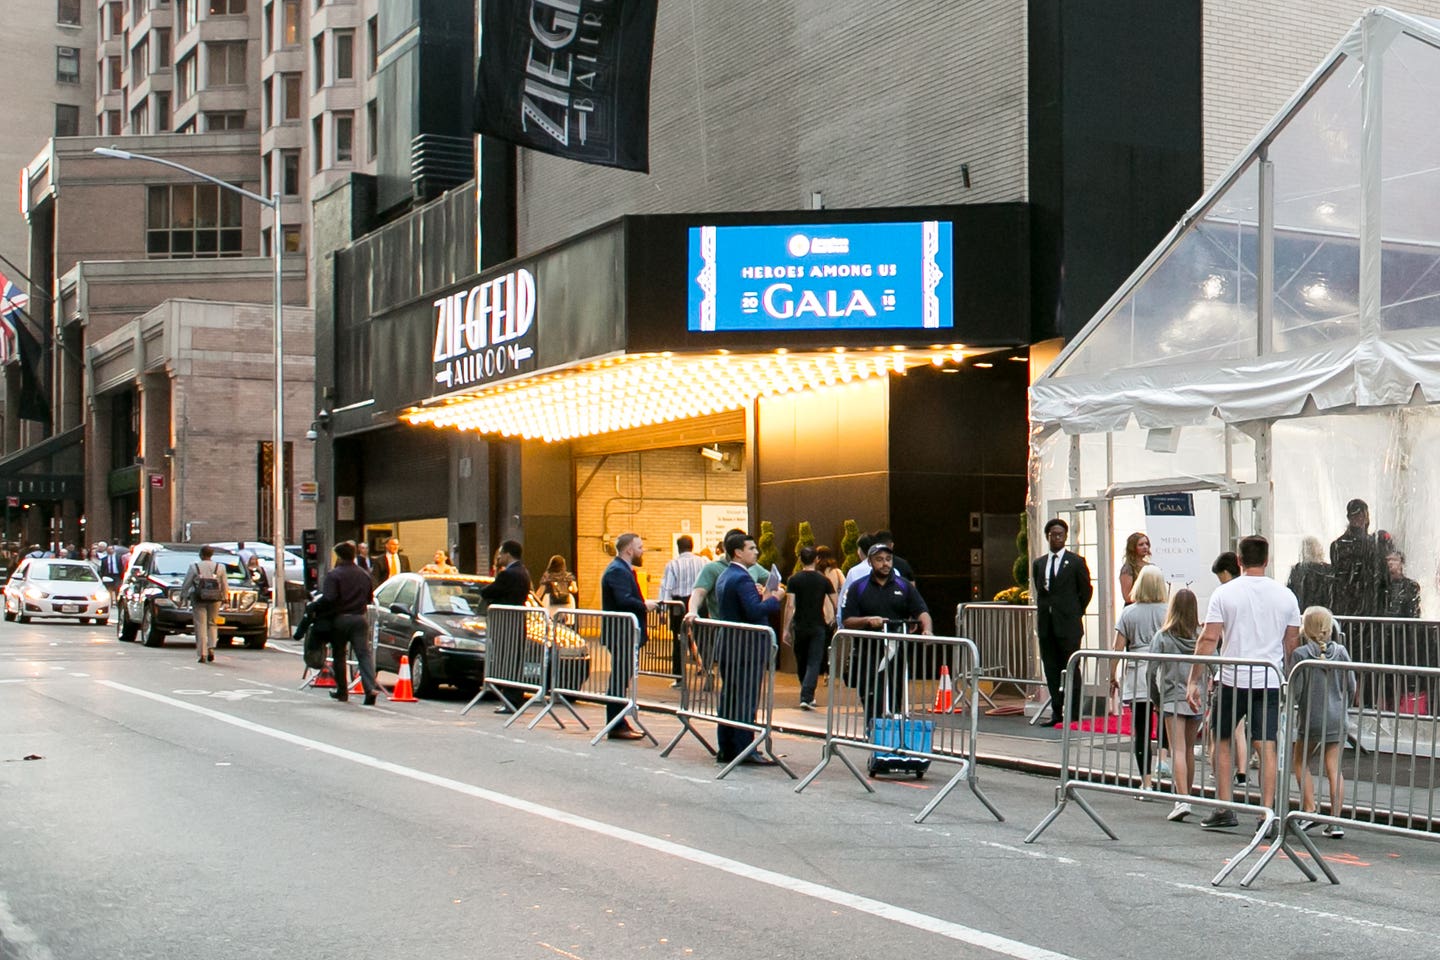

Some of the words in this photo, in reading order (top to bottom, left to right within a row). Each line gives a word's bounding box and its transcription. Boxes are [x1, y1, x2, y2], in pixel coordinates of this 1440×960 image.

[742, 265, 804, 278] HEROES
[810, 264, 873, 277] AMONG
[878, 263, 897, 276] US
[433, 268, 536, 362] ZIEGFELD
[763, 283, 877, 319] GALA
[446, 343, 520, 388] BALLROOM
